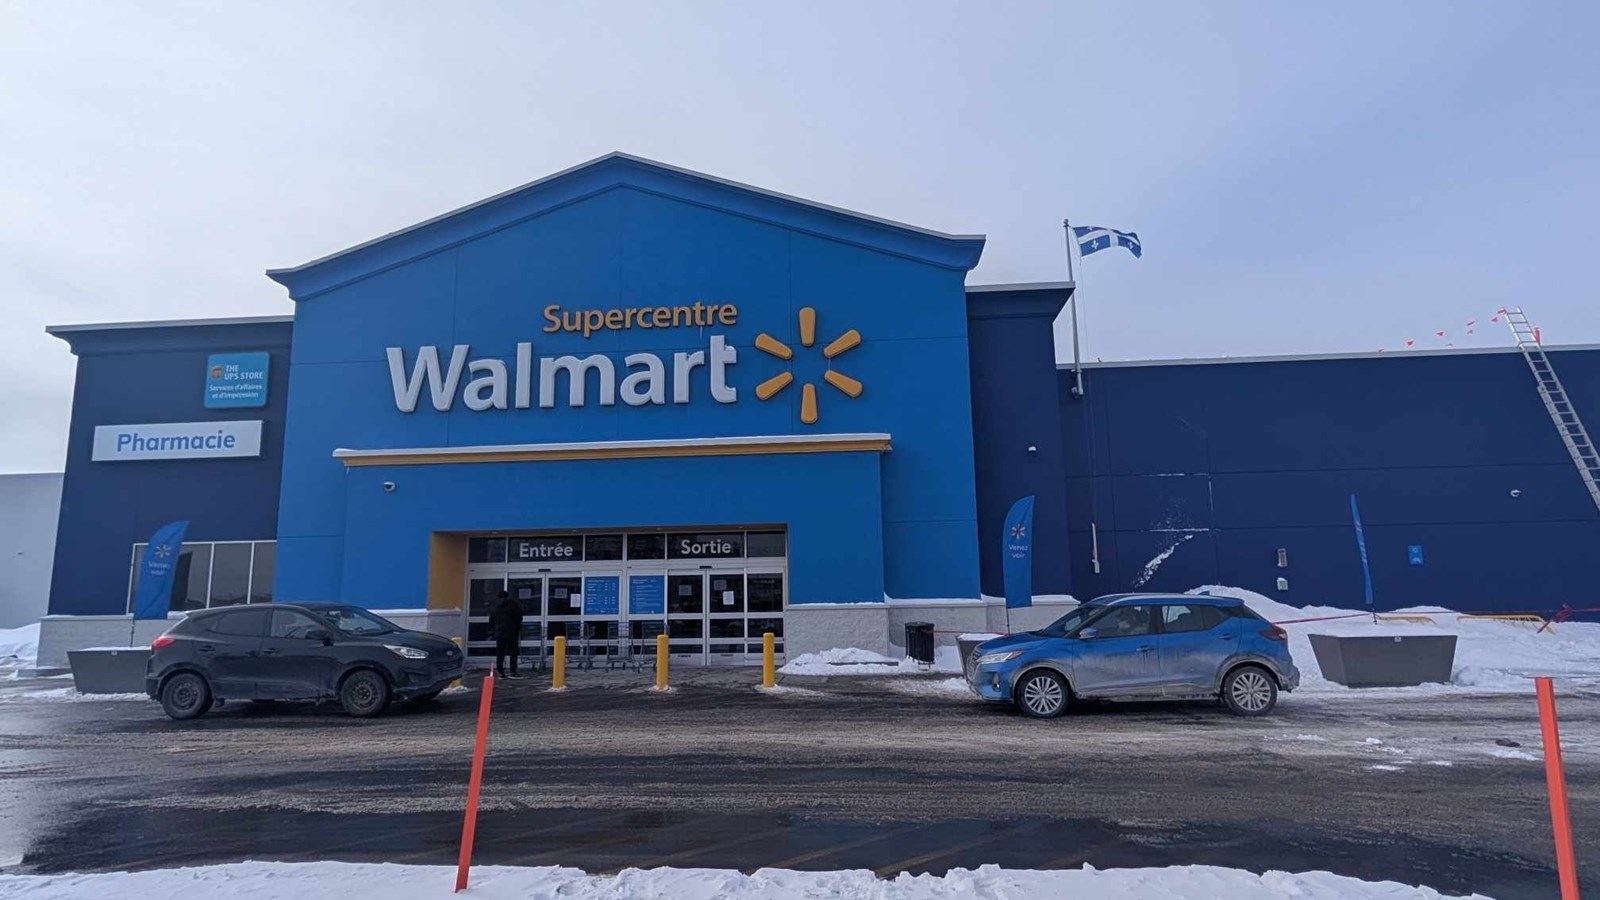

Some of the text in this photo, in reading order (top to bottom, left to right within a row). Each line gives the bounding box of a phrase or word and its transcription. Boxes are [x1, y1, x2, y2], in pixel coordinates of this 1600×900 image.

[543, 301, 737, 337] Supercentre
[225, 364, 239, 373] THE
[386, 335, 737, 412] Walmart
[224, 371, 263, 381] UPS STORE
[209, 383, 263, 392] Services d'affaires
[212, 391, 259, 400] et d'impression
[117, 430, 235, 452] Pharmacie
[519, 542, 574, 558] Entrée
[681, 538, 732, 554] Sortie
[1012, 551, 1026, 559] voir
